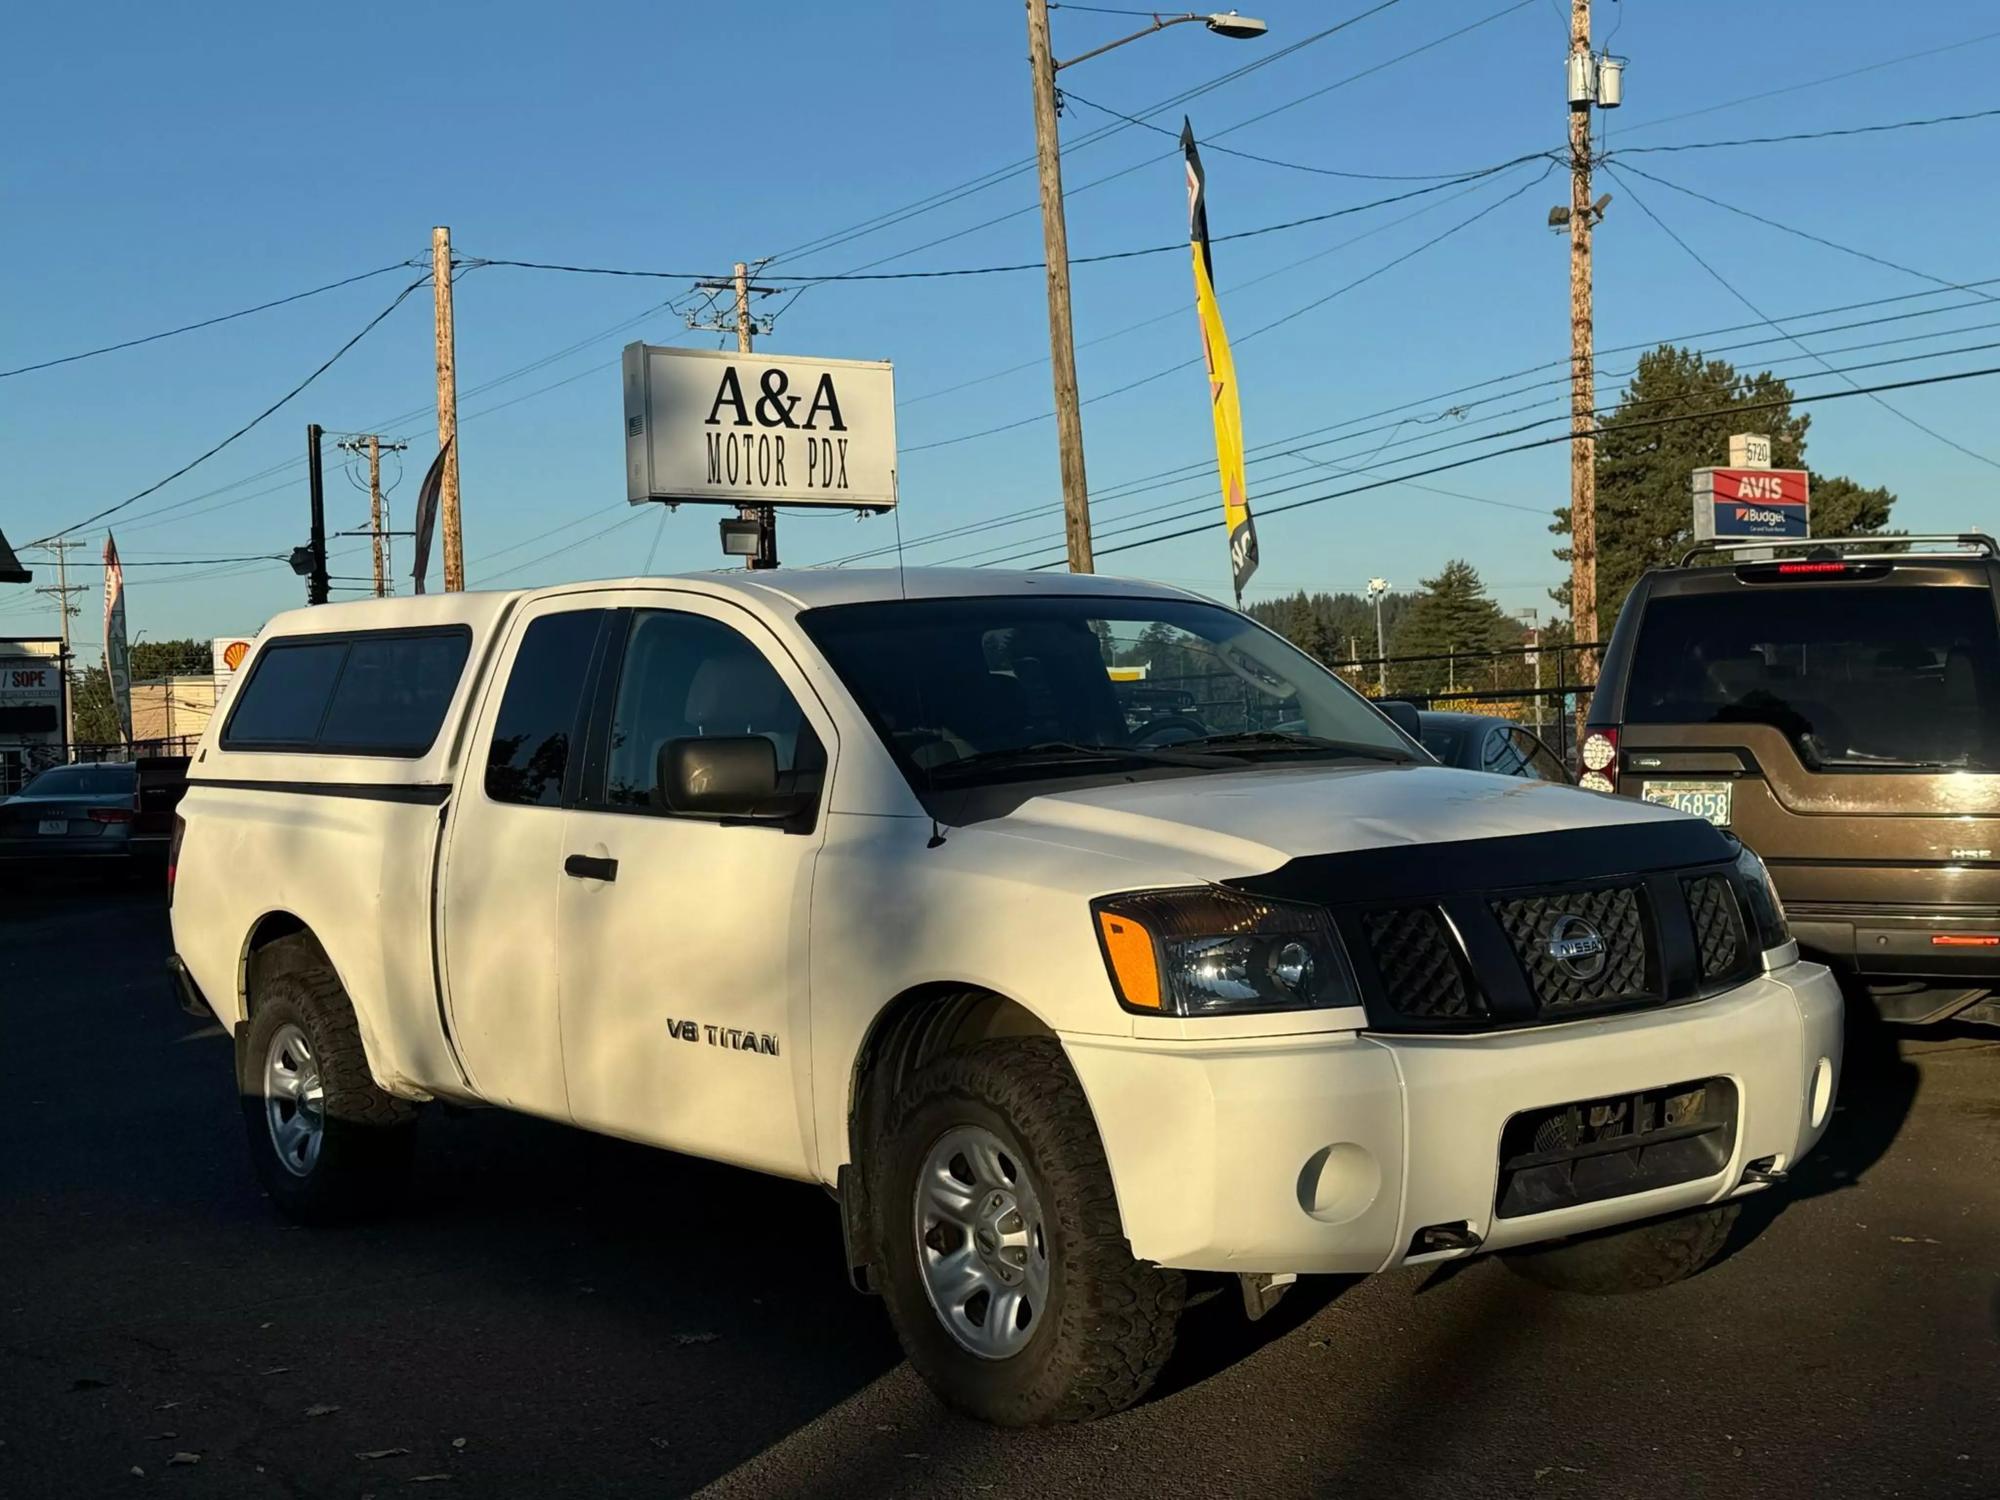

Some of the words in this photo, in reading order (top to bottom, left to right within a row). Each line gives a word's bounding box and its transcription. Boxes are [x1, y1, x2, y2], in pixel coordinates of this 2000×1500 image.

[705, 366, 848, 432] A&A
[706, 432, 787, 487] MOTOR
[808, 437, 848, 489] PDX
[1746, 442, 1768, 462] 5720
[1737, 476, 1783, 499] AVIS
[1750, 508, 1786, 526] Budget
[12, 670, 46, 688] SOPE
[666, 1018, 700, 1042] V8
[703, 1024, 780, 1056] TITAN
